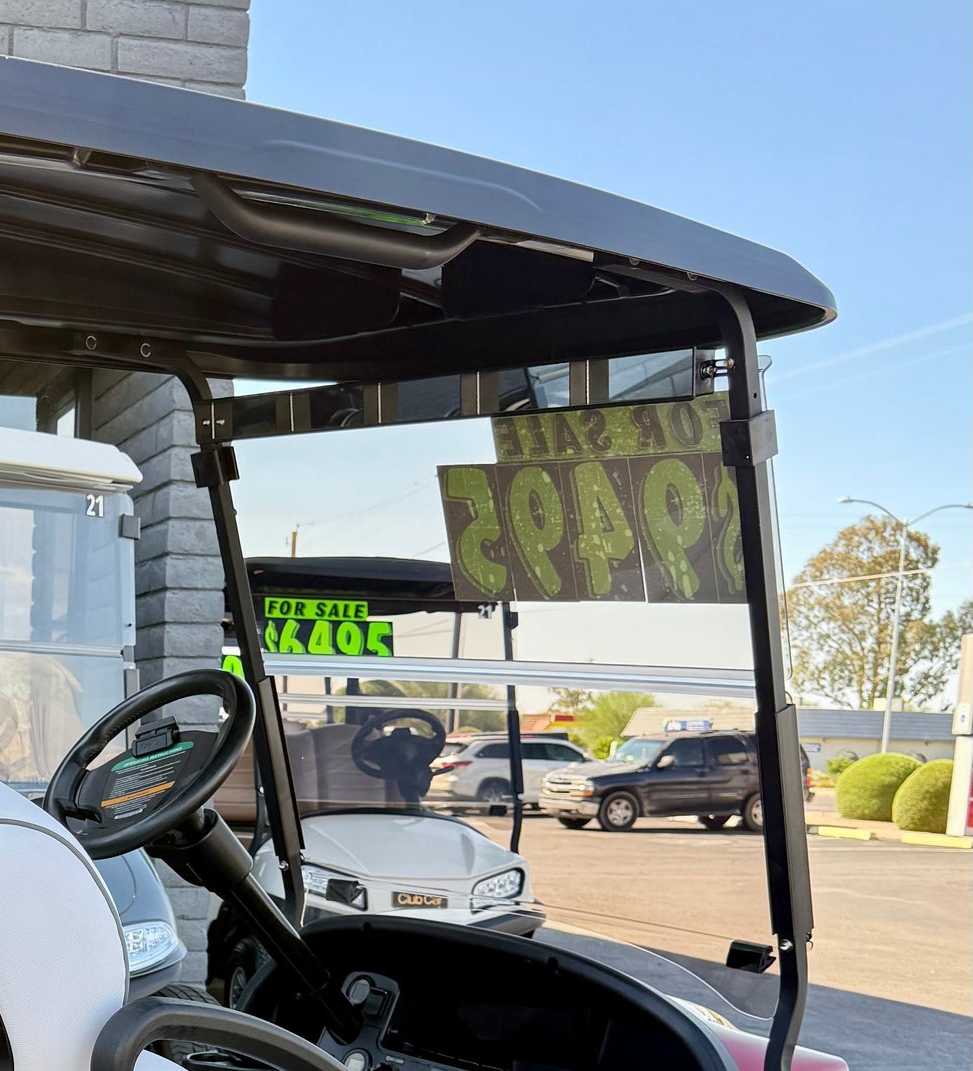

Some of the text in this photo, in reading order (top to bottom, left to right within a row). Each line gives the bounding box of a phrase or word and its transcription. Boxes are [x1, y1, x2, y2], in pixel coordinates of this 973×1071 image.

[87, 494, 104, 517] 21
[267, 600, 366, 618] FOR SALE
[398, 893, 423, 905] Club
